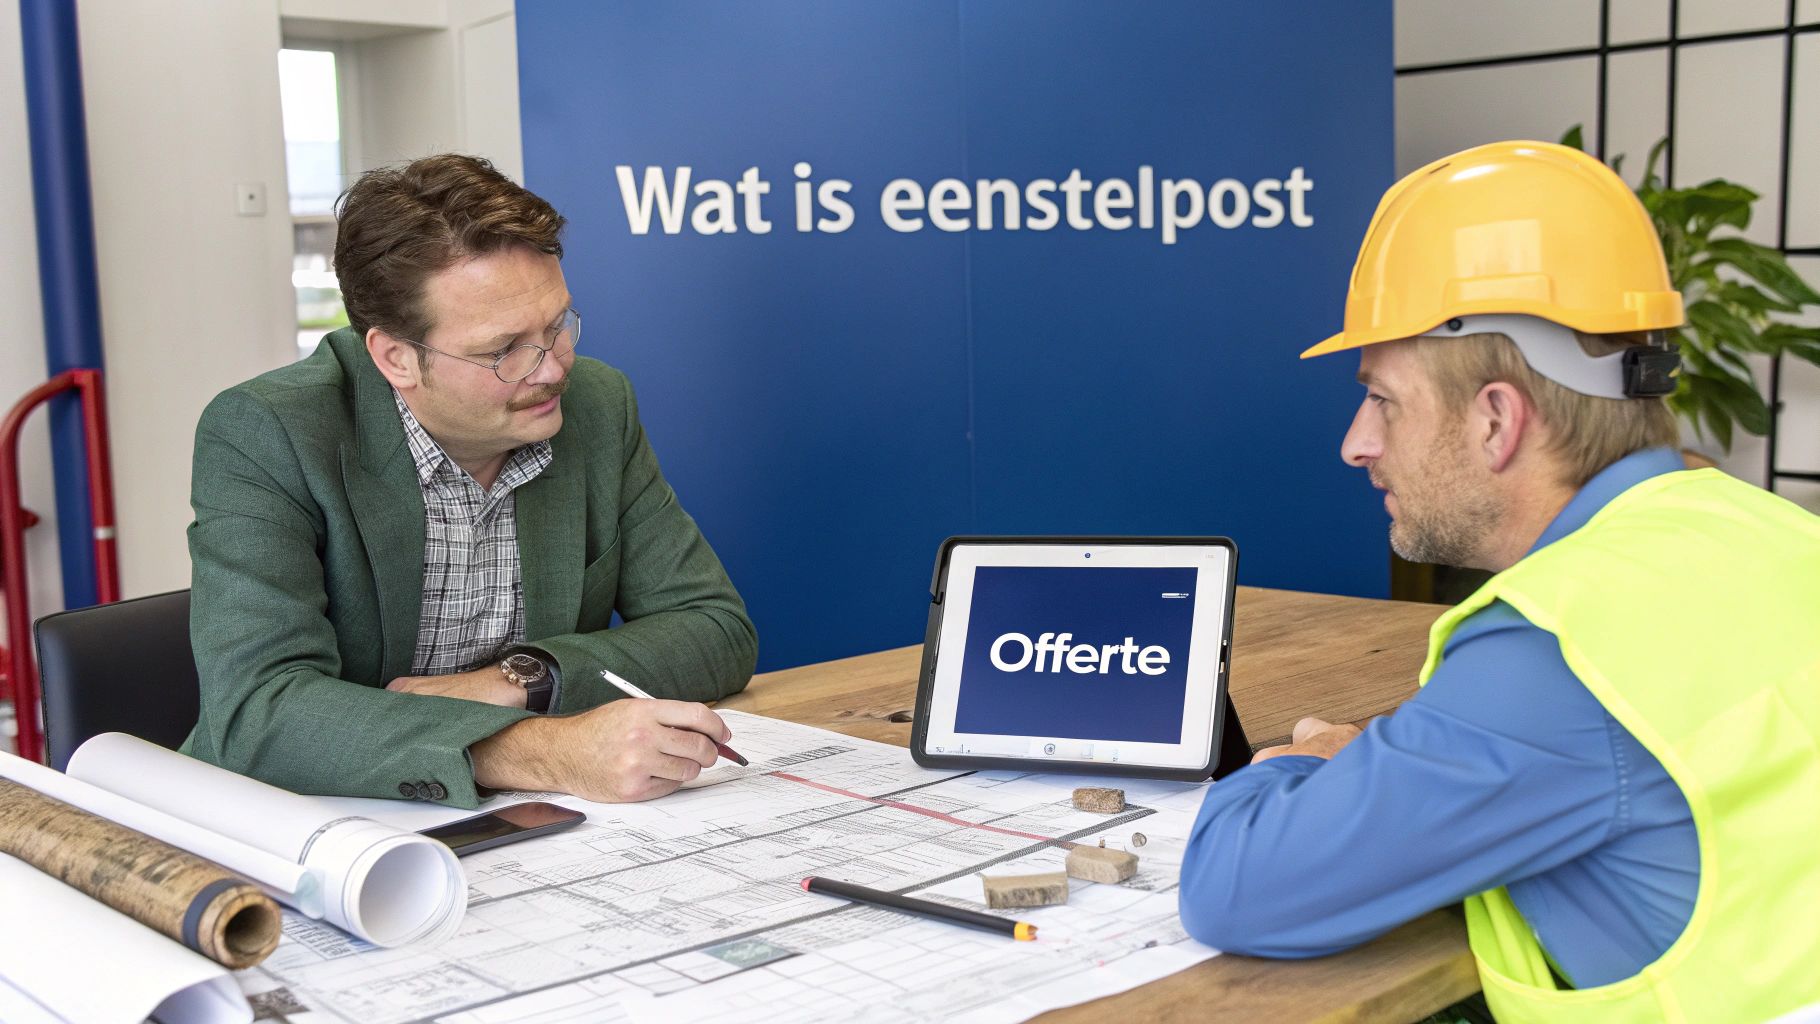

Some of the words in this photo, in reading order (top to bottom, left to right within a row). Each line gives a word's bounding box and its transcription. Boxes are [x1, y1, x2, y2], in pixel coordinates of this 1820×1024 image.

[616, 165, 771, 235] Wat
[794, 162, 855, 233] is
[881, 166, 1314, 245] eenstelpost
[990, 632, 1170, 676] Offerte
